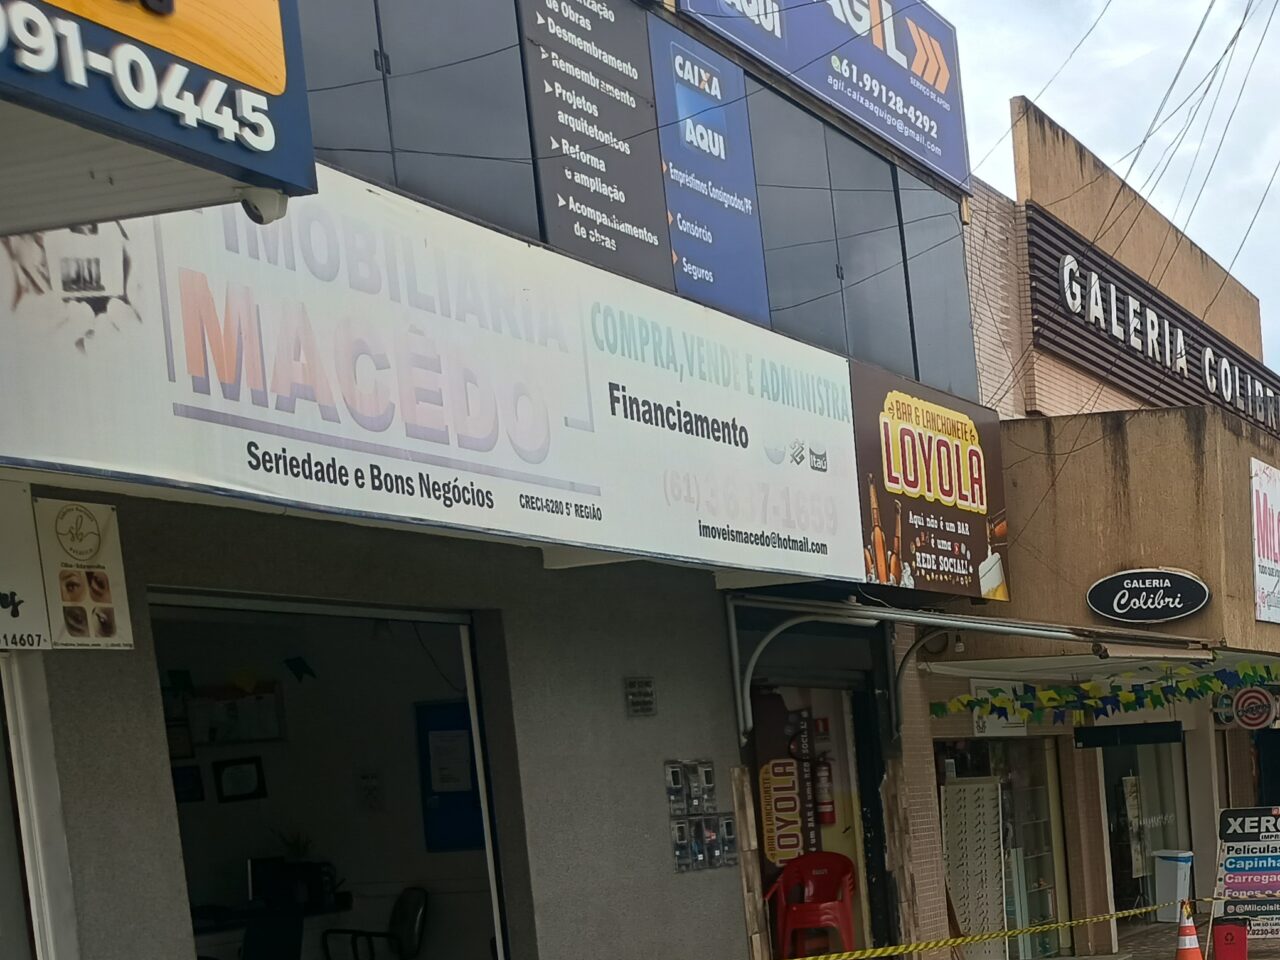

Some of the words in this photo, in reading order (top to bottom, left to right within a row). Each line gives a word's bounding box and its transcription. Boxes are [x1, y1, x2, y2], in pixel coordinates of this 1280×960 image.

[561, 1, 592, 32] Obras
[547, 16, 639, 80] Desmembramento
[0, 0, 276, 153] 91-0445
[551, 51, 636, 108] Remembramento
[674, 55, 722, 100] CAIXA
[554, 81, 599, 117] Projetos
[841, 58, 938, 139] 61.99128-4292
[561, 138, 606, 172] Reforma
[685, 118, 726, 160] AQUI
[574, 171, 626, 203] ampliação
[573, 221, 587, 239] de
[676, 212, 713, 244] Consórcio
[682, 257, 714, 283] Seguros
[1059, 254, 1190, 380] GALERIA
[760, 356, 850, 424] ADMINISTRA
[608, 381, 750, 449] Financiamento
[895, 399, 913, 425] BAR
[921, 409, 970, 442] LANCHONETE
[246, 440, 349, 488] Seriedade
[353, 468, 367, 489] e
[369, 462, 416, 498] Bons
[417, 471, 496, 509] Negócios
[883, 420, 985, 508] LOYOLA
[518, 492, 565, 517] CRECI-6280
[574, 502, 603, 522] REGIÃO
[909, 510, 924, 530] Aqui
[926, 513, 939, 530] não
[945, 522, 956, 533] um
[957, 520, 970, 536] BAR
[697, 519, 829, 556] imoveismacedo@hotmail.com
[937, 538, 952, 551] uma
[915, 551, 937, 571] REDE
[939, 555, 969, 576] SOCIAL!
[1112, 589, 1184, 614] Colibri
[1123, 579, 1172, 589] GALERIA
[1225, 888, 1261, 898] Fones
